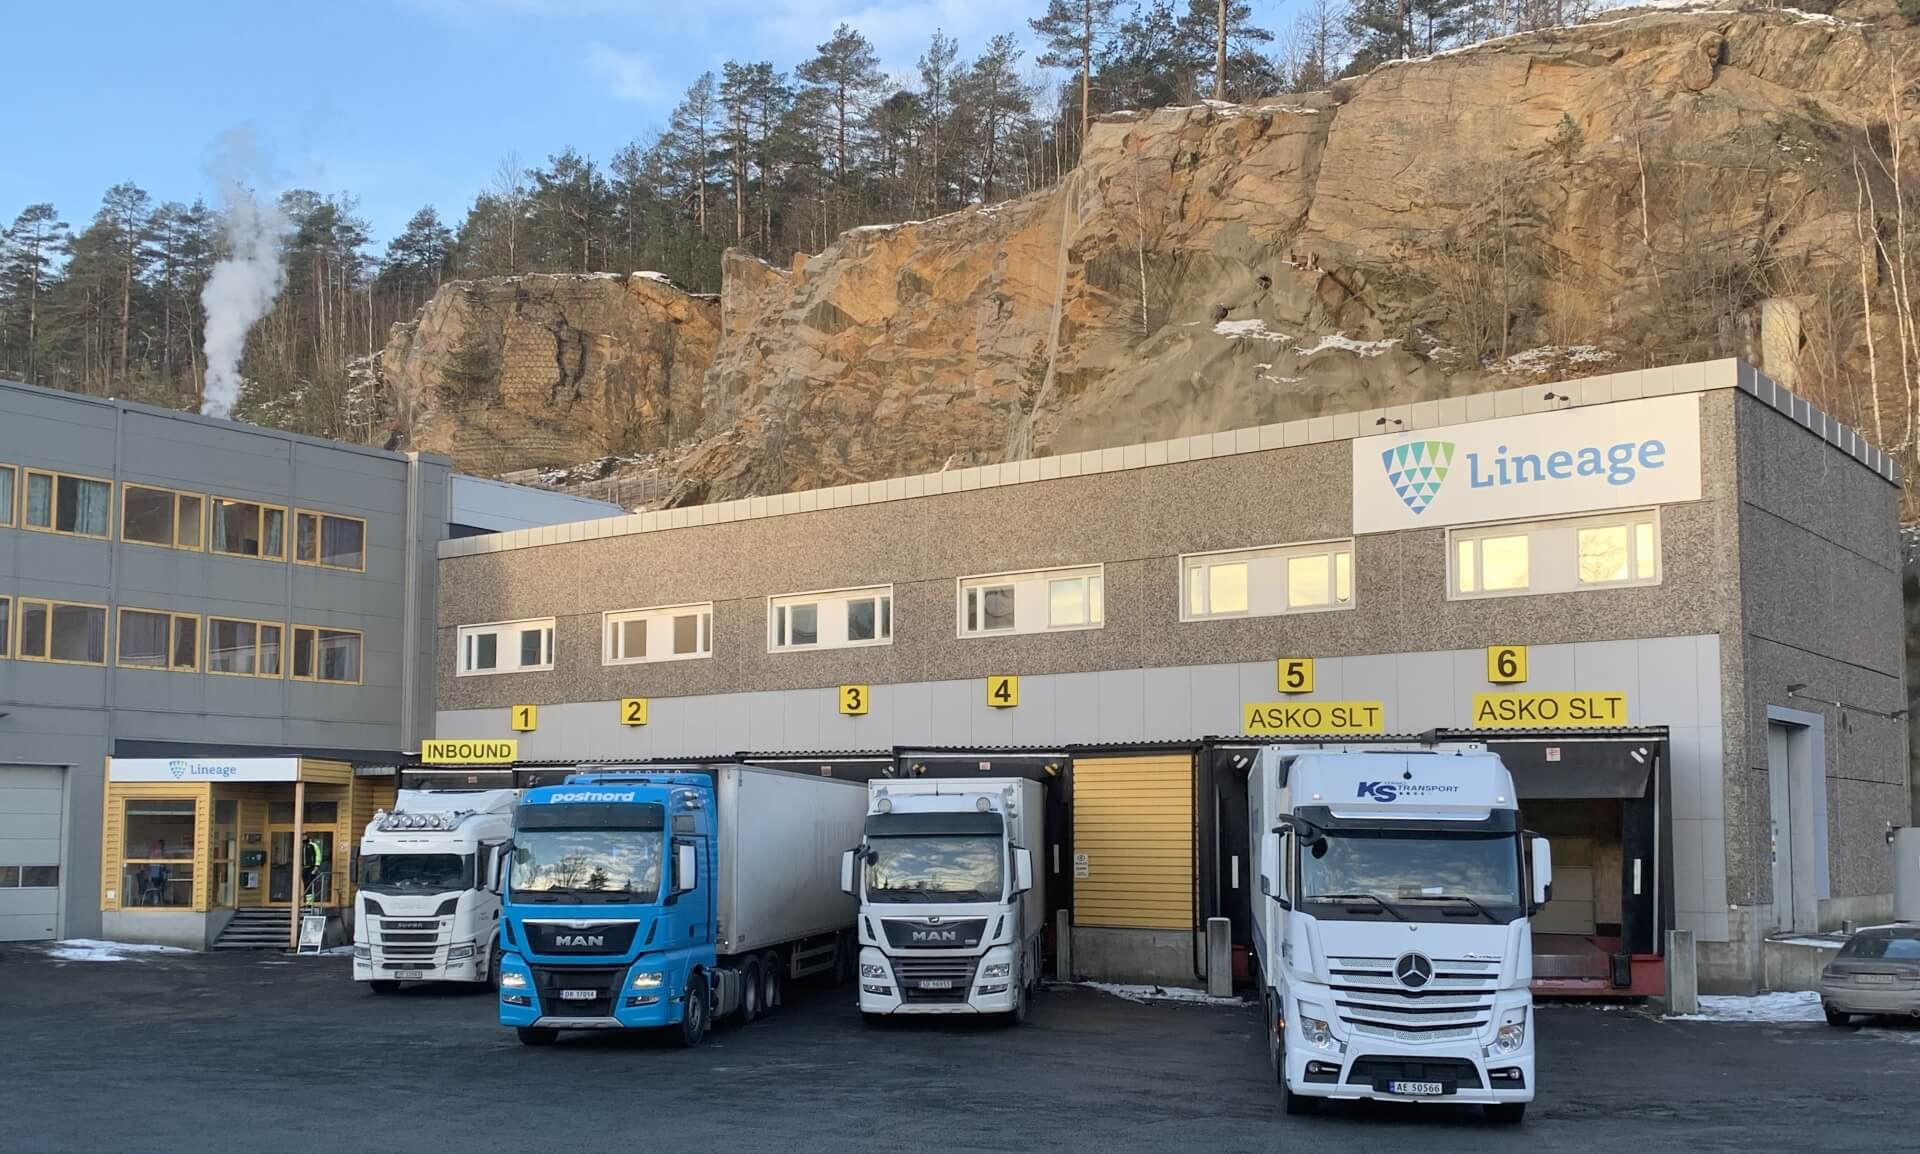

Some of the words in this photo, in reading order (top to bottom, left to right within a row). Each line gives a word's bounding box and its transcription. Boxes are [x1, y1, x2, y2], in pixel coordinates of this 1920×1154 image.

[1466, 438, 1667, 489] Lineage
[1497, 649, 1518, 678] 6
[1286, 662, 1305, 688] 5
[846, 688, 861, 710] 3
[994, 679, 1011, 703] 4
[519, 708, 529, 727] 1
[627, 701, 641, 722] 2
[1249, 708, 1322, 729] ASKO
[1331, 707, 1379, 728] SLT
[1478, 698, 1559, 721] ASKO
[1569, 697, 1622, 720] SLT
[427, 744, 512, 759] INBOUND
[190, 763, 237, 778] Lineage
[550, 791, 635, 804] postnord
[1357, 781, 1397, 802] KS
[1397, 785, 1459, 793] TRANSPORT
[555, 935, 604, 946] MAN
[912, 931, 956, 941] MAN
[1396, 1083, 1408, 1092] AE
[1411, 1083, 1441, 1093] 50566
